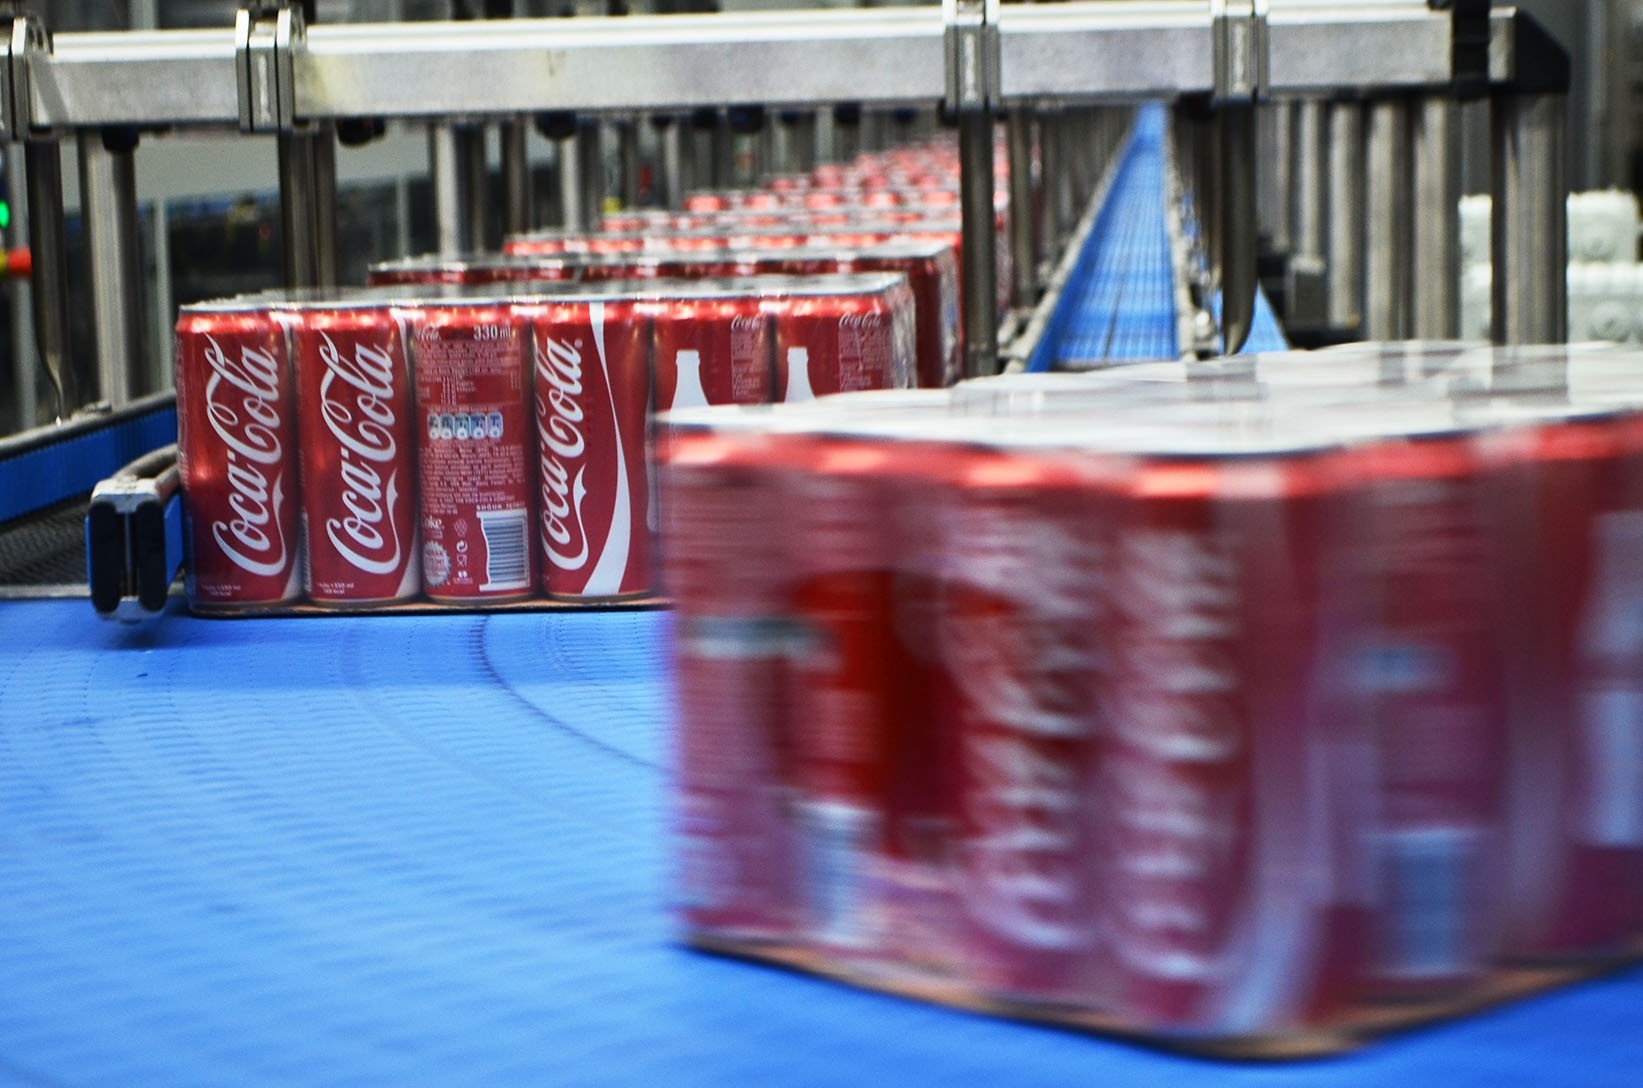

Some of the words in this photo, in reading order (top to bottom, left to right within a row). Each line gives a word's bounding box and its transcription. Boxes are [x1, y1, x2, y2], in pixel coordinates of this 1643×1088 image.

[204, 331, 287, 577] Coca-Cola
[319, 330, 401, 575] Coca-Cola
[473, 325, 498, 340] 330
[500, 325, 511, 340] ml
[533, 327, 589, 571] Coca-Cola
